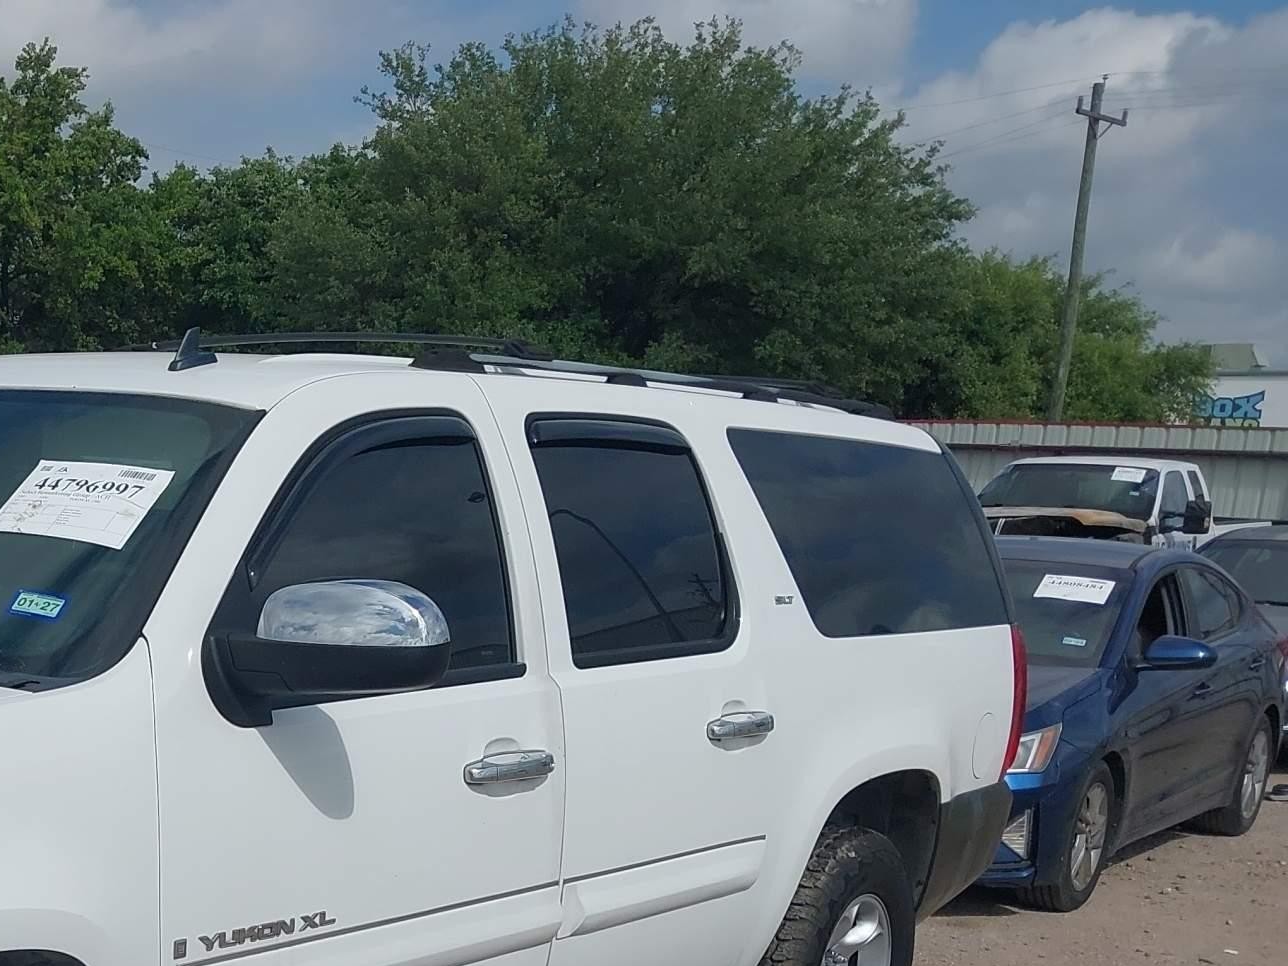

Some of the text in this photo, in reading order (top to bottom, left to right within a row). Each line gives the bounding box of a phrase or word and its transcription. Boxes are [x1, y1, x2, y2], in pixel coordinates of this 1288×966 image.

[34, 476, 146, 499] 44796997
[198, 917, 296, 952] YUKON
[299, 910, 337, 933] XL
